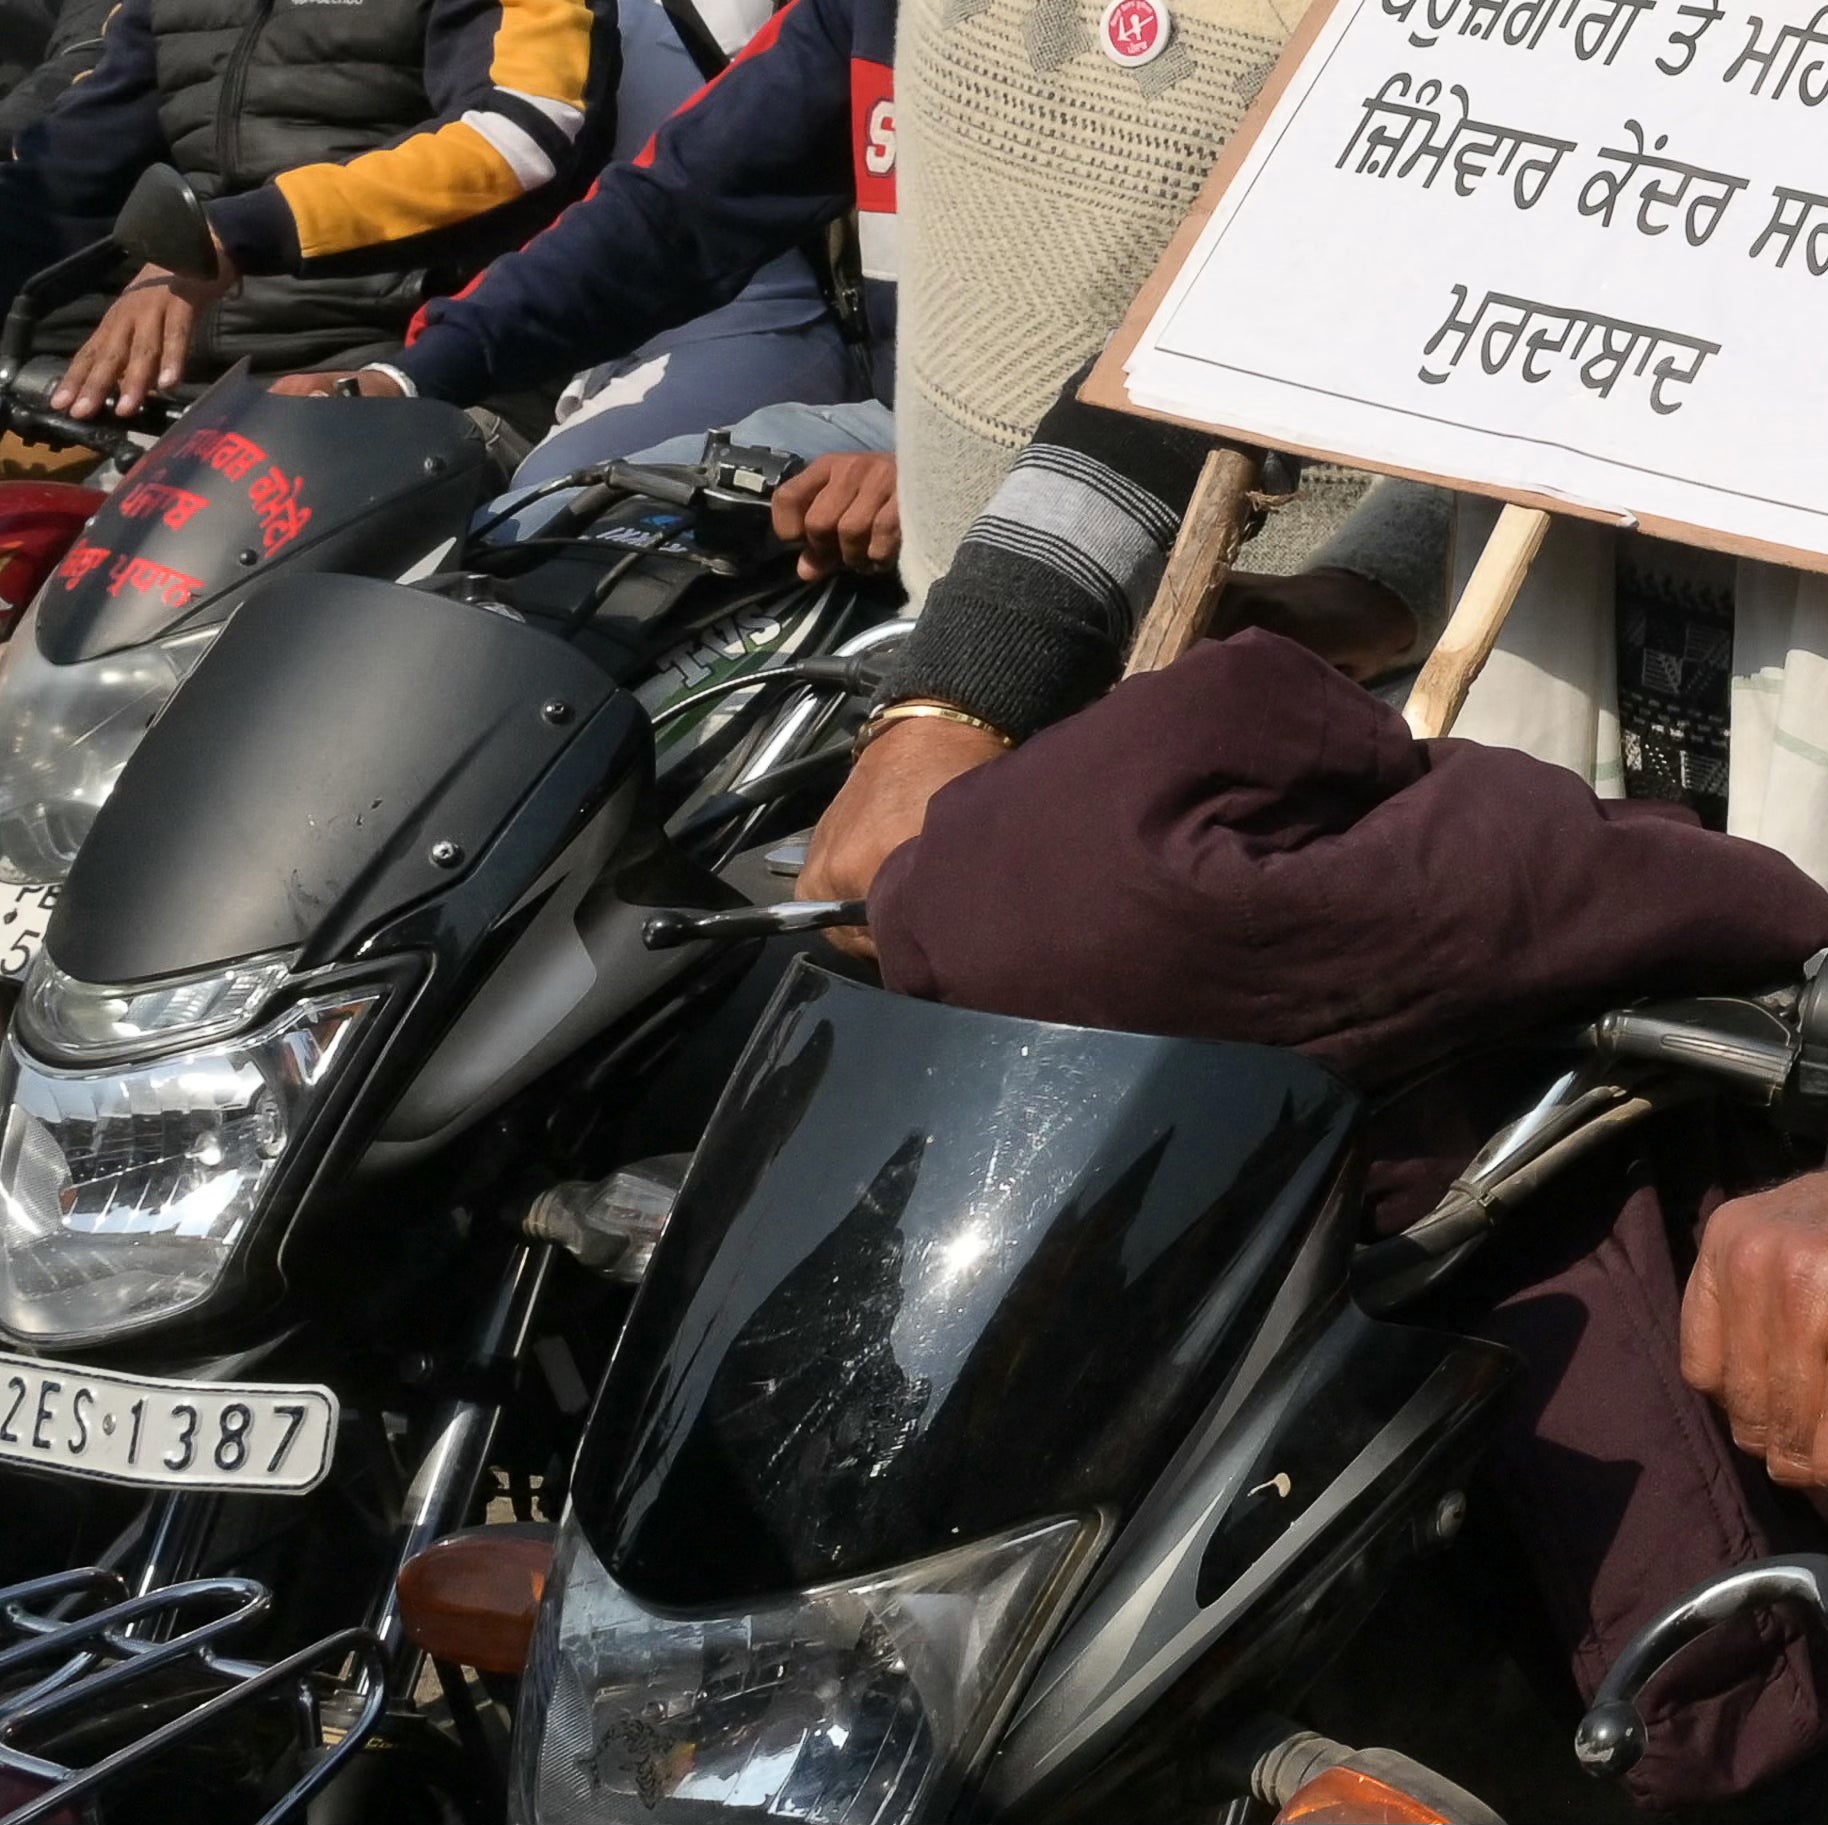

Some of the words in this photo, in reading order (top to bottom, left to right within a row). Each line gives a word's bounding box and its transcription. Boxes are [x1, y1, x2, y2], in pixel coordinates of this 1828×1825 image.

[1335, 72, 1578, 210] ਜ਼ਿੰਮੇਵਾਰ
[1577, 119, 1751, 247] ਕੇਂਦਰ
[1417, 283, 1722, 415] ਮੁਰਦਾਬਾਦ
[656, 616, 781, 689] TVS
[127, 1398, 306, 1473] 1387
